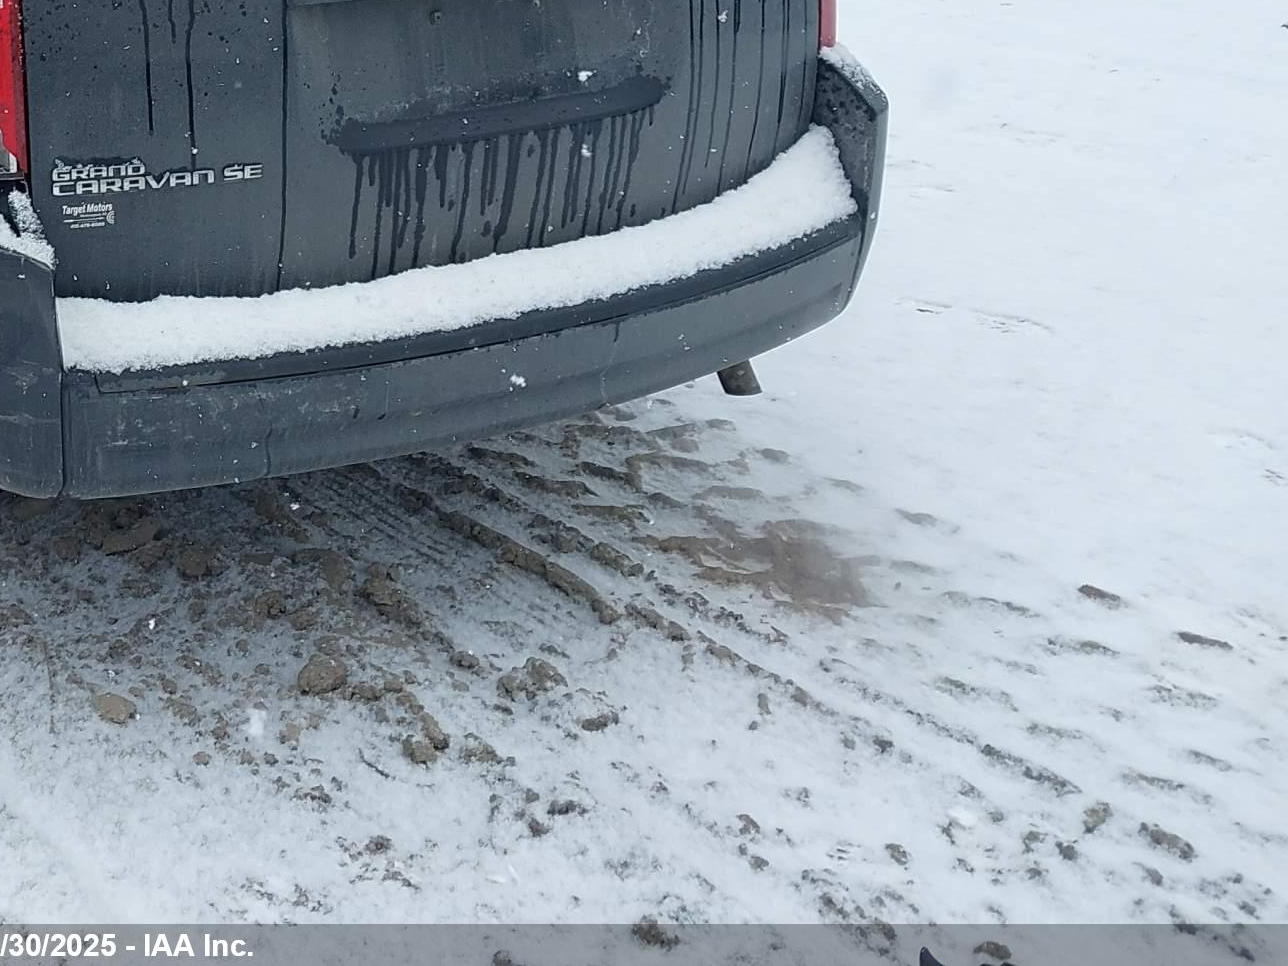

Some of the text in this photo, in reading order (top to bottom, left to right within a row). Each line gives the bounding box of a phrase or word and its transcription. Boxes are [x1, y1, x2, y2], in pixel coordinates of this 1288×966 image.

[52, 163, 146, 181] GRAND
[53, 164, 263, 196] CARAVAN SE
[62, 204, 86, 216] Target
[86, 203, 113, 213] Motors
